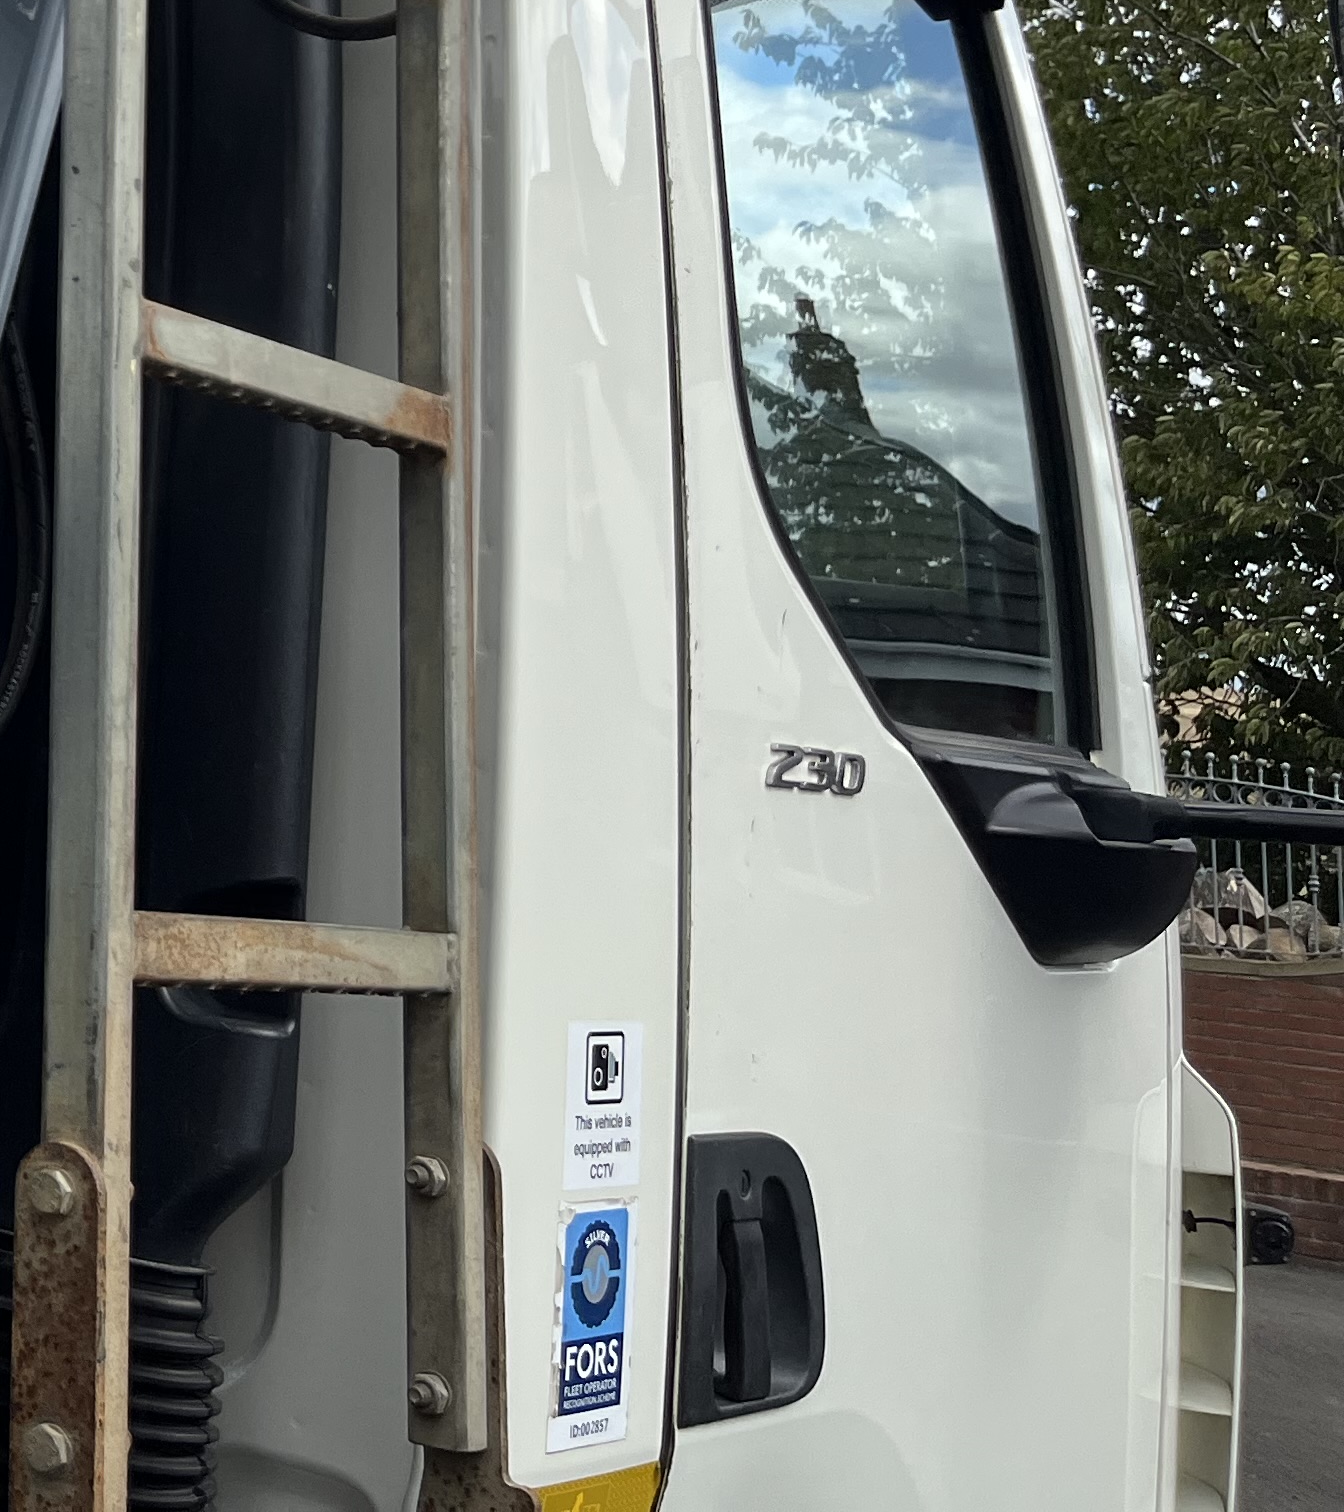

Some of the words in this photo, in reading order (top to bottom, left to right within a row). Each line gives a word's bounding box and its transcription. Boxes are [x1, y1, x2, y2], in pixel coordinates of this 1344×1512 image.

[765, 742, 866, 797] 230
[575, 1115, 592, 1130] This
[594, 1113, 623, 1129] vehicle
[625, 1112, 632, 1128] is
[574, 1138, 613, 1158] equipped
[615, 1138, 631, 1152] with
[590, 1162, 614, 1179] CCTV
[584, 1229, 611, 1249] SILVER
[564, 1338, 618, 1381] FORS
[564, 1383, 583, 1398] FLEET
[584, 1377, 617, 1394] OPERATOR
[569, 1417, 609, 1439] ID:002857
